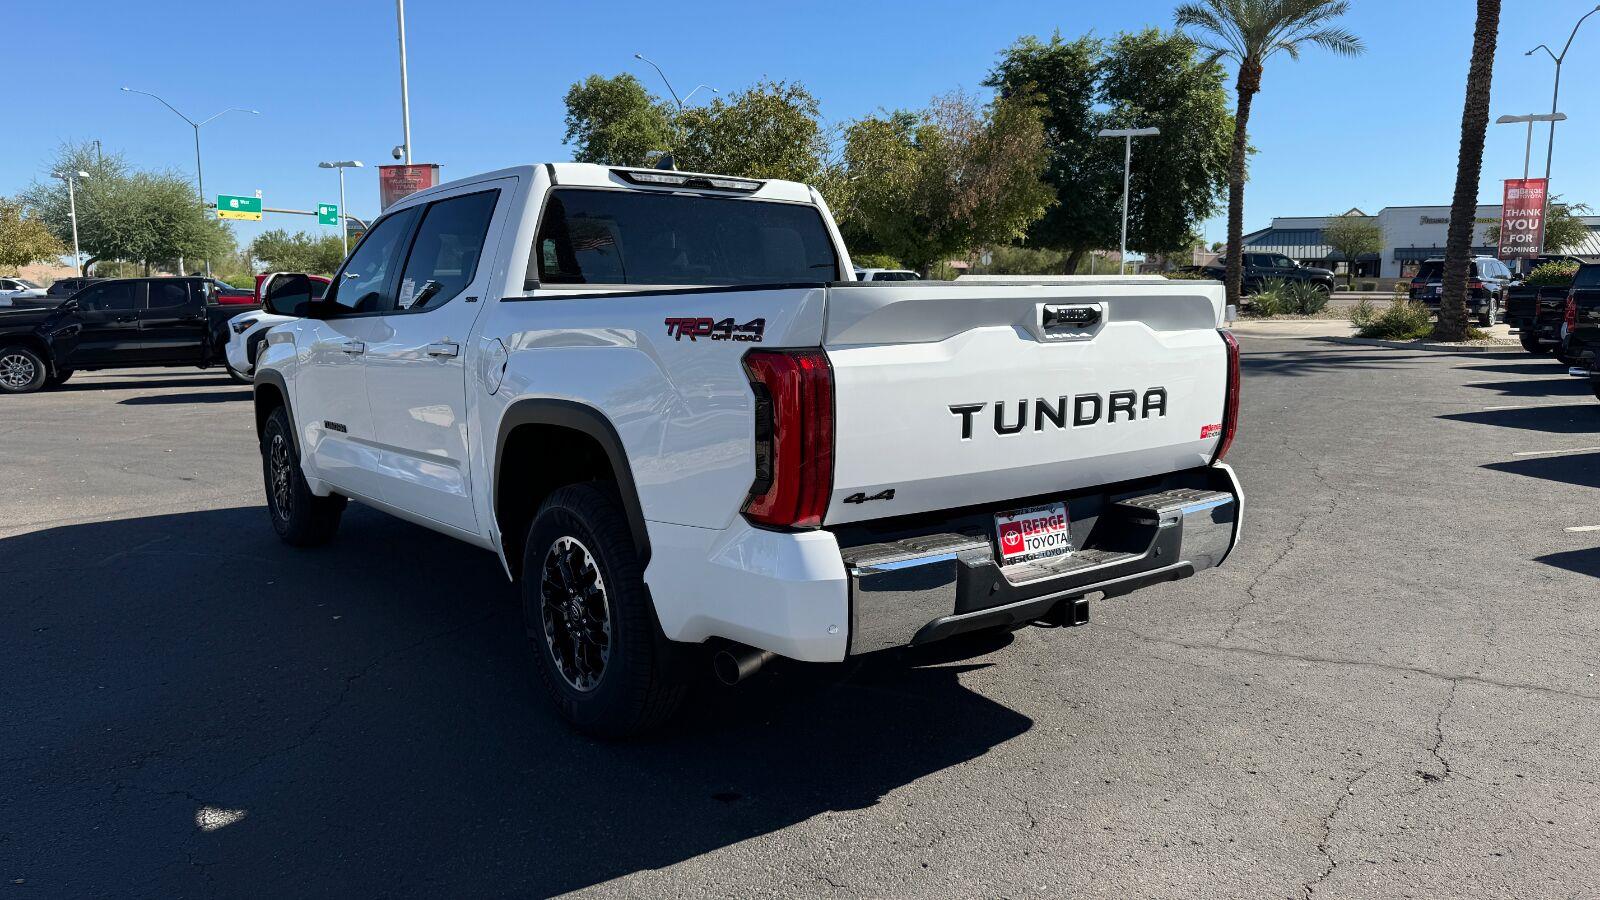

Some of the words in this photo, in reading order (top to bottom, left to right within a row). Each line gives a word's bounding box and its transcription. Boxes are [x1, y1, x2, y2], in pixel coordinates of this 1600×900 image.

[1506, 208, 1541, 217] THANK
[1506, 218, 1539, 230] YOU
[1509, 234, 1533, 243] FOR
[664, 317, 714, 341] TRD
[732, 333, 763, 342] ROAD
[948, 386, 1168, 441] TUNDRA
[1021, 514, 1065, 536] BERGE
[1025, 532, 1068, 551] TOYOTA
